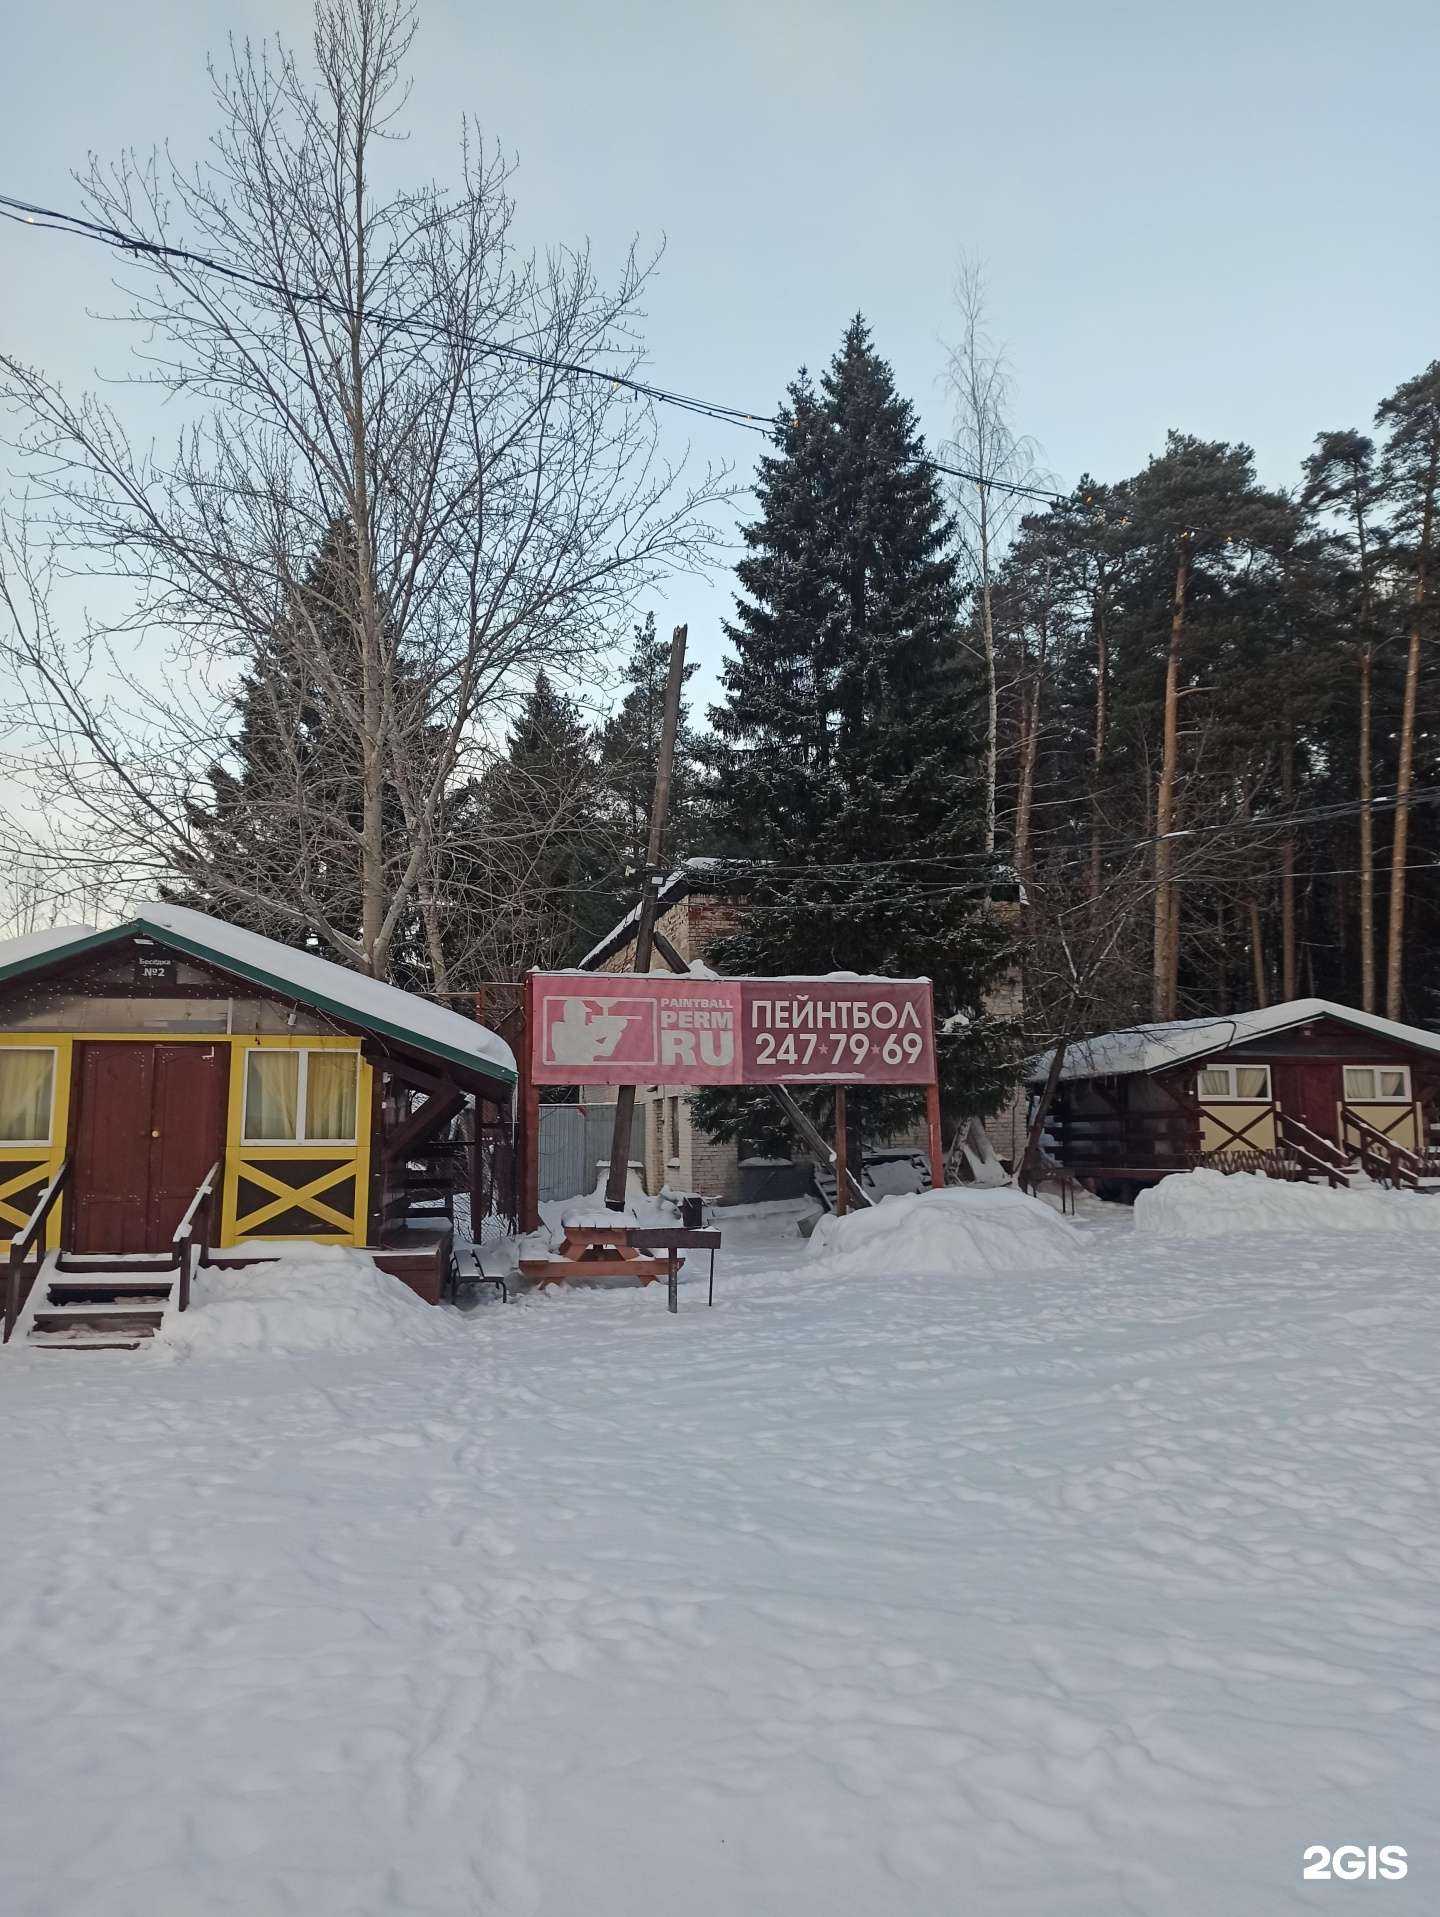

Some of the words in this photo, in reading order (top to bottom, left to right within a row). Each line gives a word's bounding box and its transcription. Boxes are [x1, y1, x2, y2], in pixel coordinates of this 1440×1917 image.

[661, 998, 733, 1009] PAINTBALL
[752, 994, 922, 1029] ПЕЙНТБОЛ
[661, 1010, 733, 1029] PERM
[661, 1030, 734, 1067] RU
